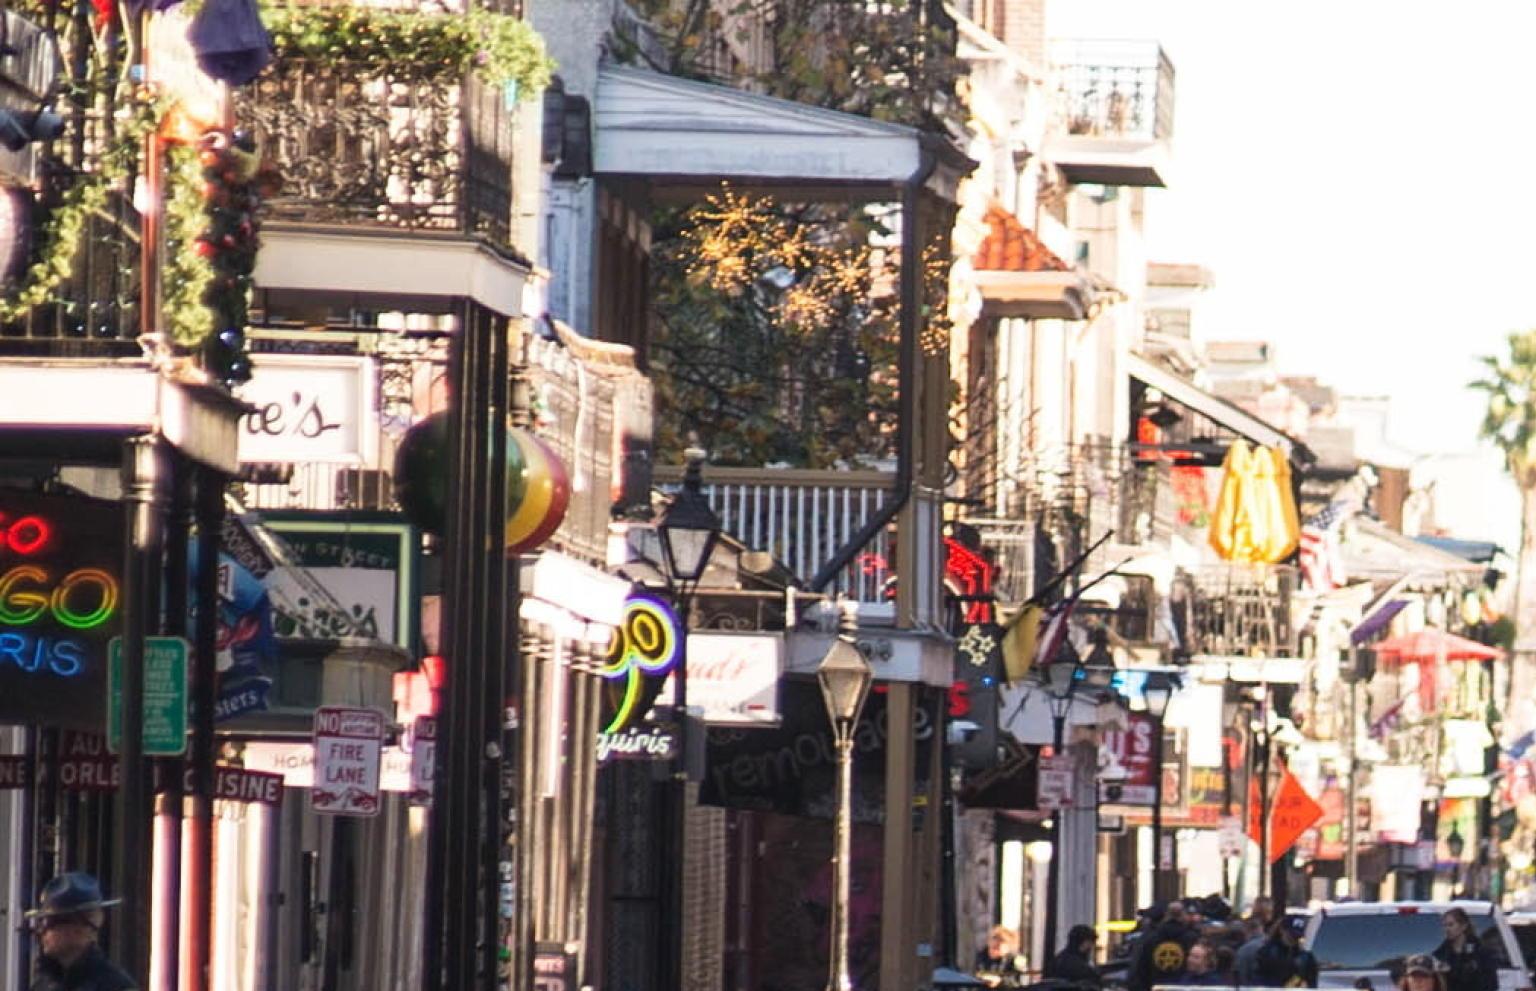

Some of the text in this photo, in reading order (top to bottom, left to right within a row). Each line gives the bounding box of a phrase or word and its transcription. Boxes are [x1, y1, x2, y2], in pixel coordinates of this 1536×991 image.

[317, 712, 340, 733] NO
[329, 743, 366, 762] FIRE
[325, 765, 367, 785] LANE
